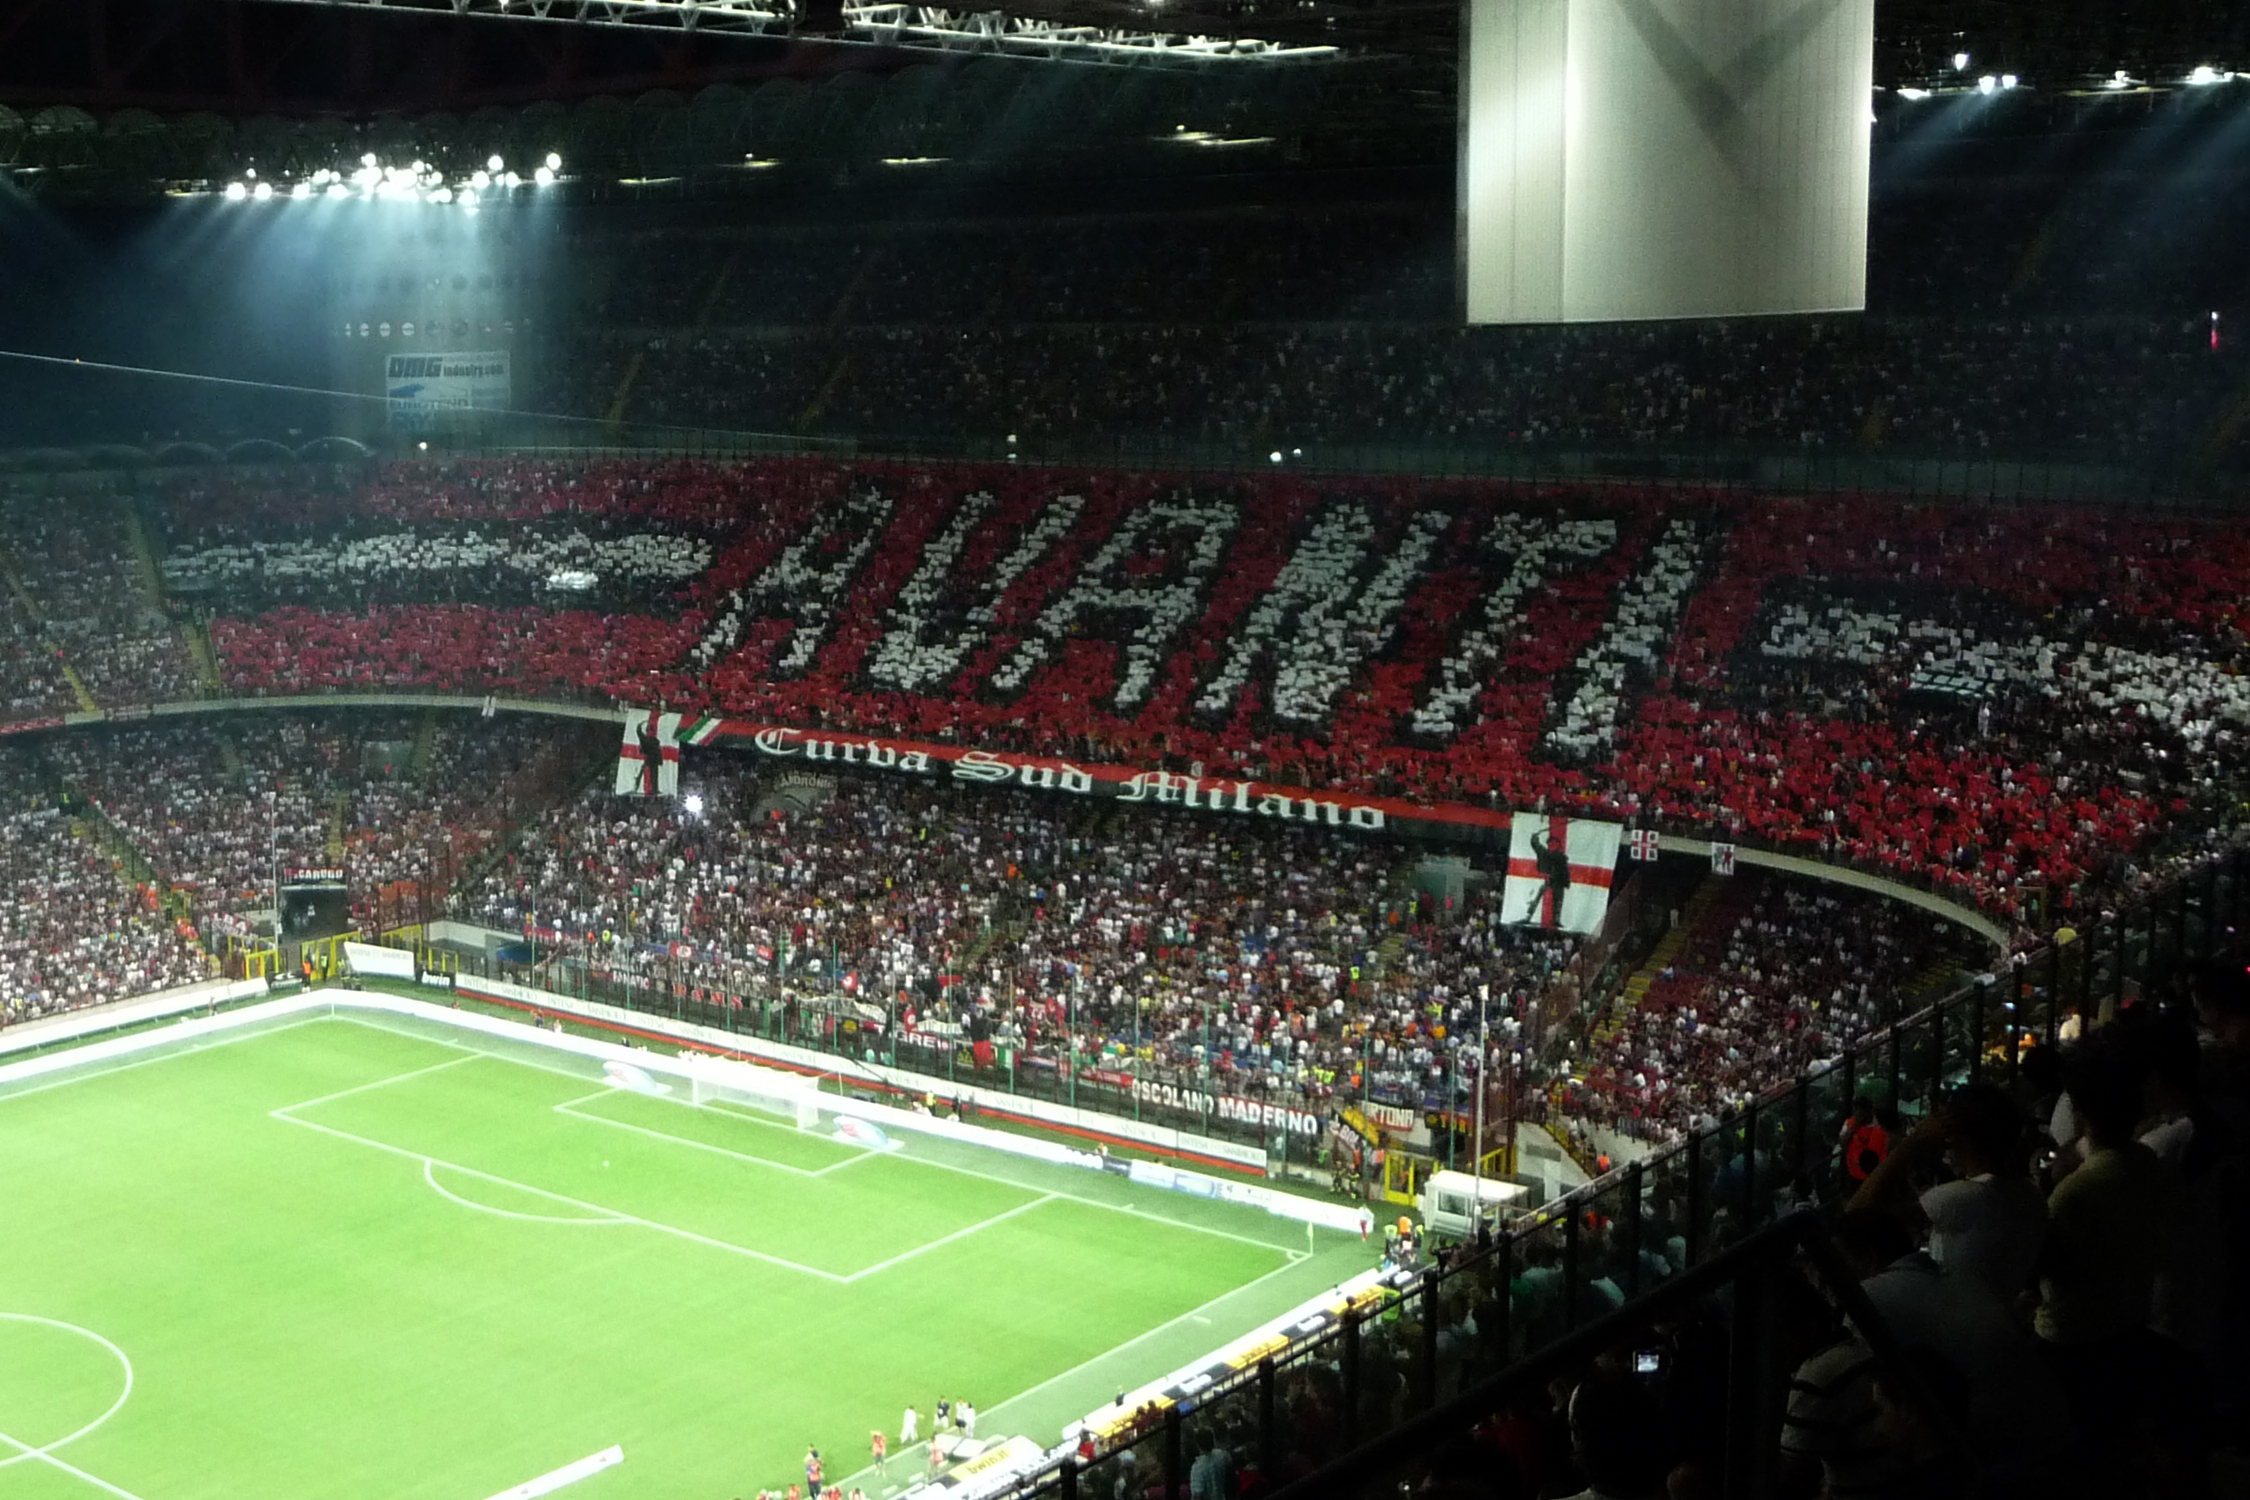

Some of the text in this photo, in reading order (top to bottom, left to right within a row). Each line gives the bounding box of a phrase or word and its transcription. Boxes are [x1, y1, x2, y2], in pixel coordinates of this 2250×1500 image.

[754, 727, 1385, 829] Curva Sud Milano
[422, 971, 450, 986] bwin
[1121, 1078, 1215, 1115] OSCOLANO
[1217, 1096, 1318, 1135] MADERNO
